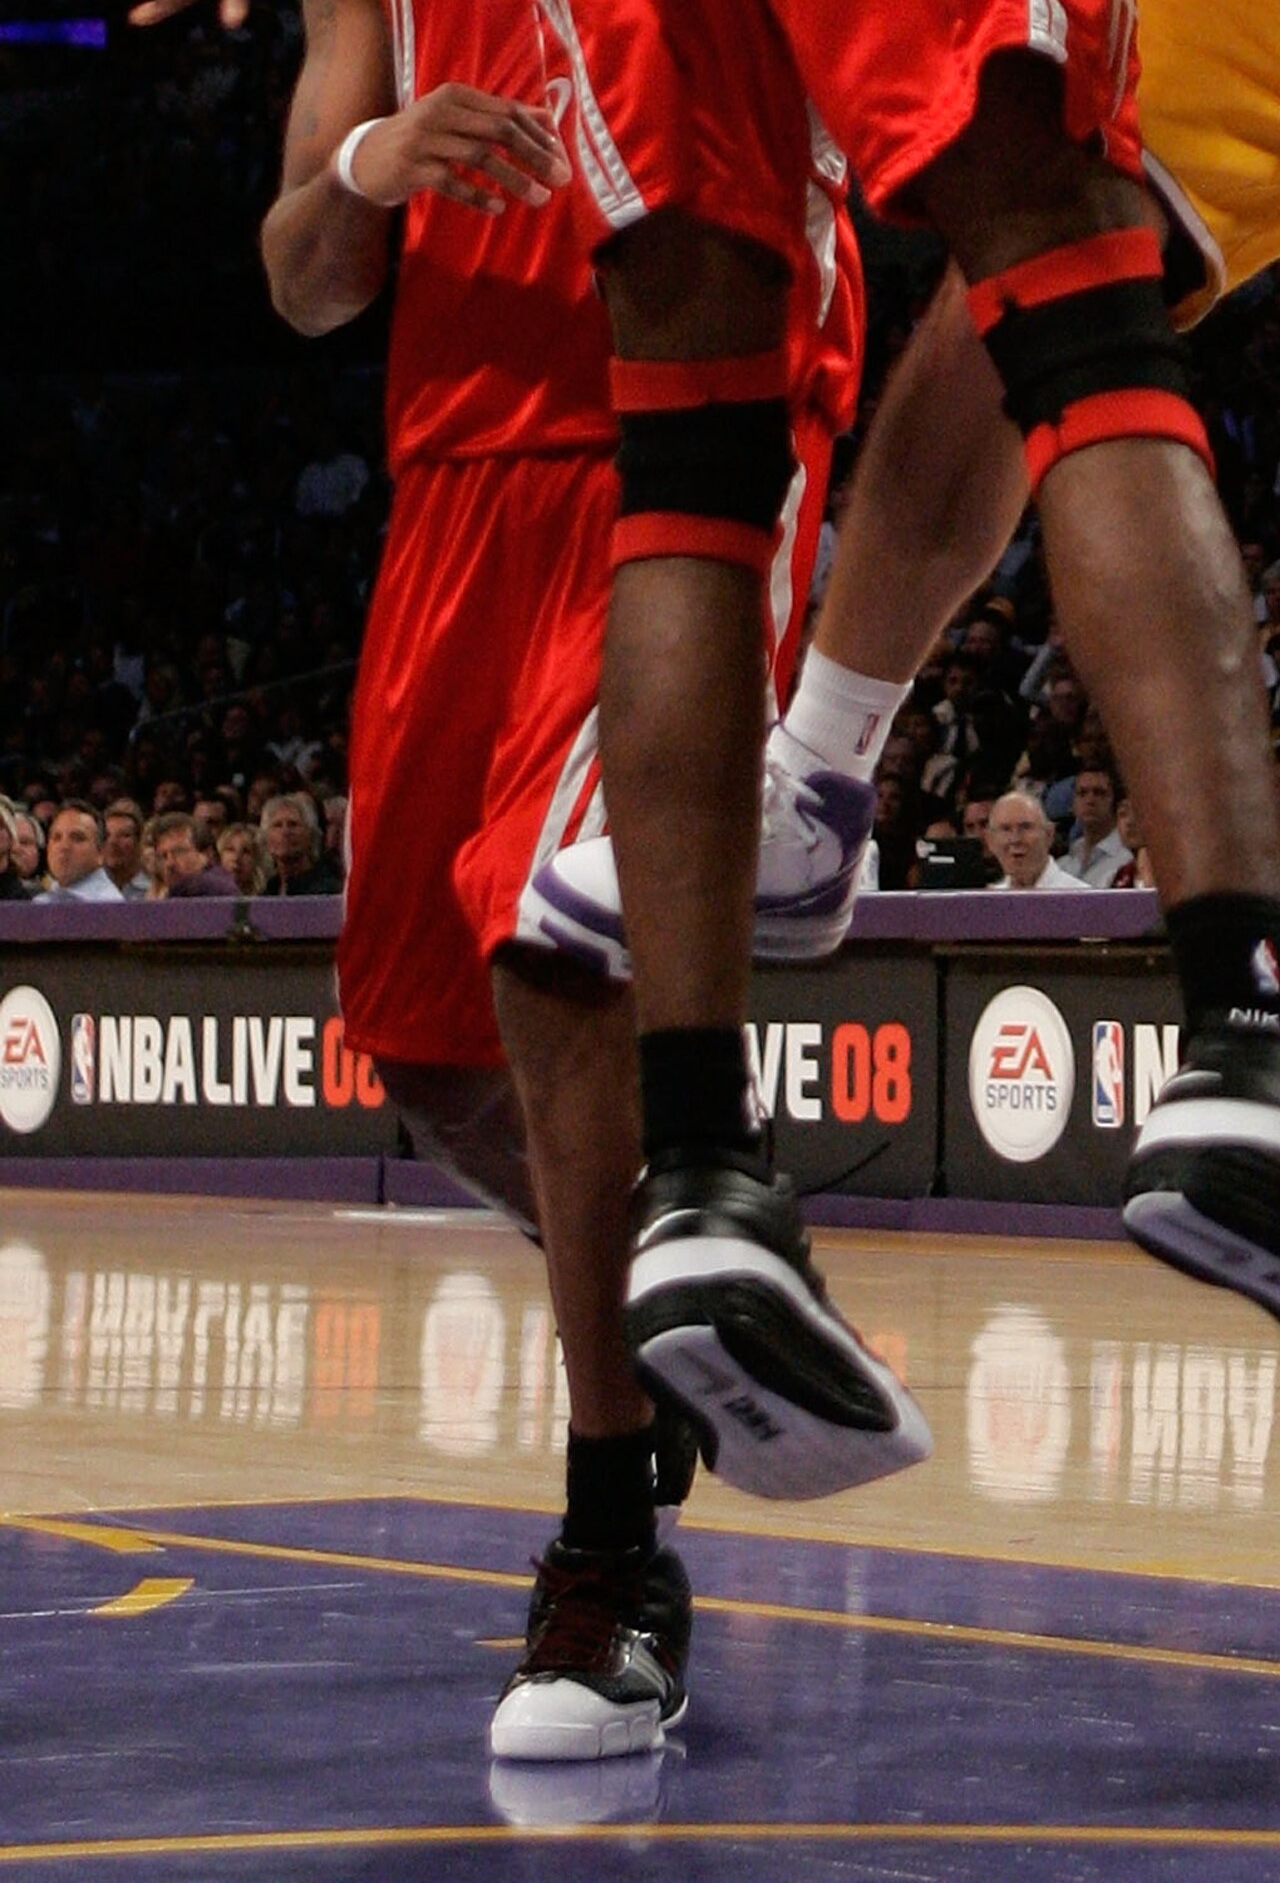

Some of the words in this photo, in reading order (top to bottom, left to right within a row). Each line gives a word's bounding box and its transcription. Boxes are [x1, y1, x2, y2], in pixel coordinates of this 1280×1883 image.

[5, 1017, 46, 1064] EA
[100, 1016, 197, 1105] NBA
[203, 1016, 316, 1107] LIVE
[988, 1024, 1054, 1081] EA
[831, 1022, 912, 1122] 08
[985, 1084, 1057, 1112] SPORTS
